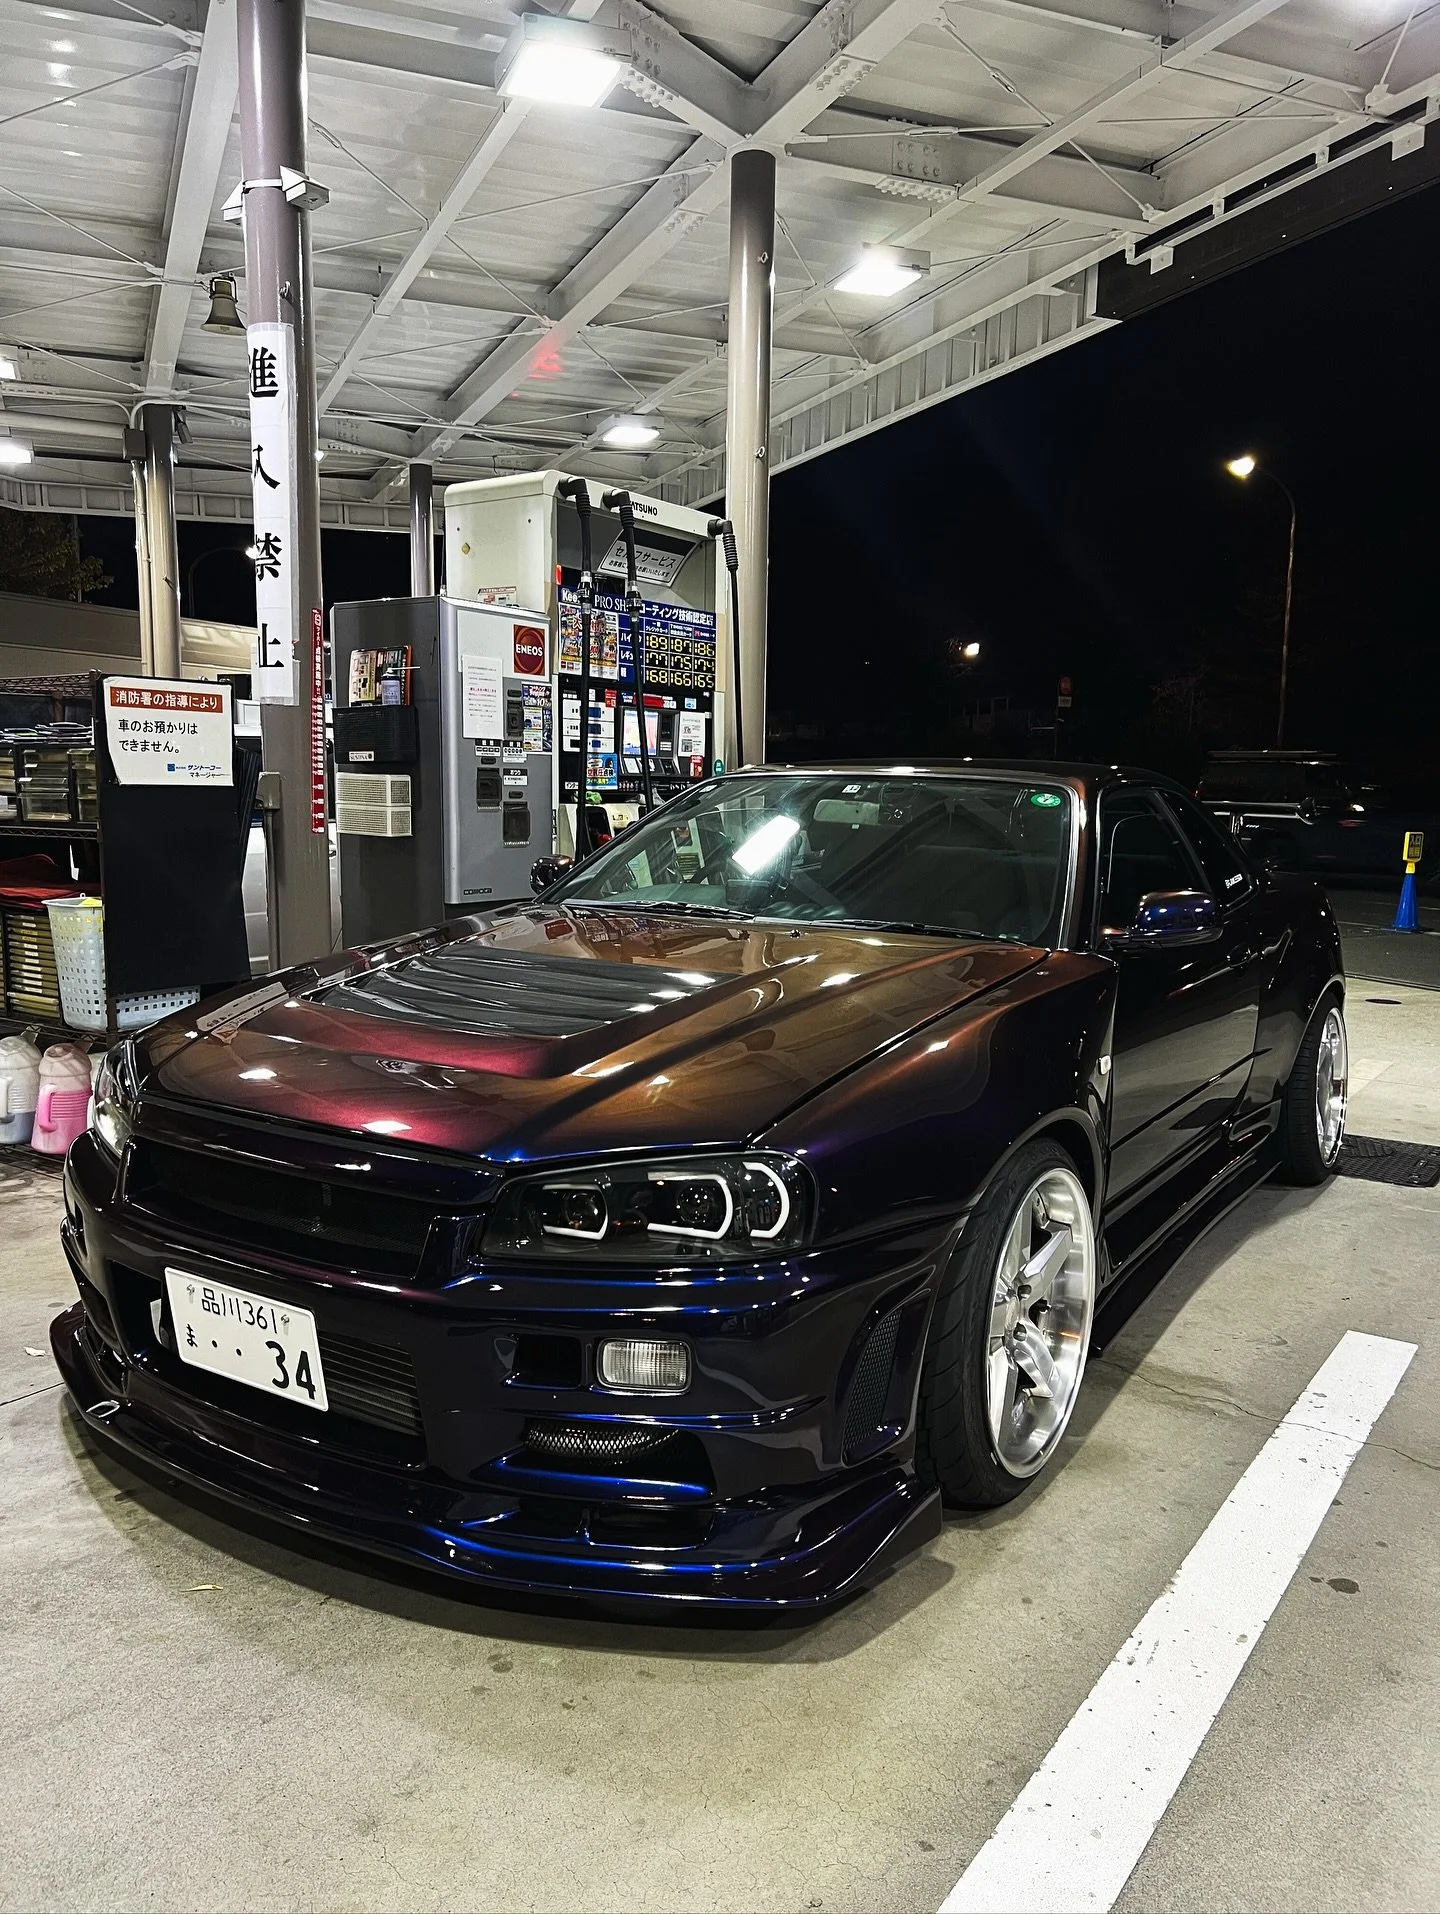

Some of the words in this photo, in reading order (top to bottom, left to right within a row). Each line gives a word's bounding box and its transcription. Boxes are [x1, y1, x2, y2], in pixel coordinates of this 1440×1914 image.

[631, 501, 658, 516] ATSUNO
[595, 594, 613, 610] PRO
[515, 644, 543, 657] ENEOS
[646, 635, 668, 650] 189
[671, 639, 692, 653] 187
[694, 642, 715, 657] 186
[646, 652, 668, 666] 177
[671, 655, 692, 670] 175
[694, 659, 715, 672] 174
[646, 669, 668, 684] 168
[670, 672, 692, 687] 166
[694, 674, 715, 689] 165
[116, 690, 218, 710] 消防署の指導により
[118, 718, 198, 735] 車のお預かりは
[118, 738, 180, 754] できません。
[186, 1323, 198, 1348] ま
